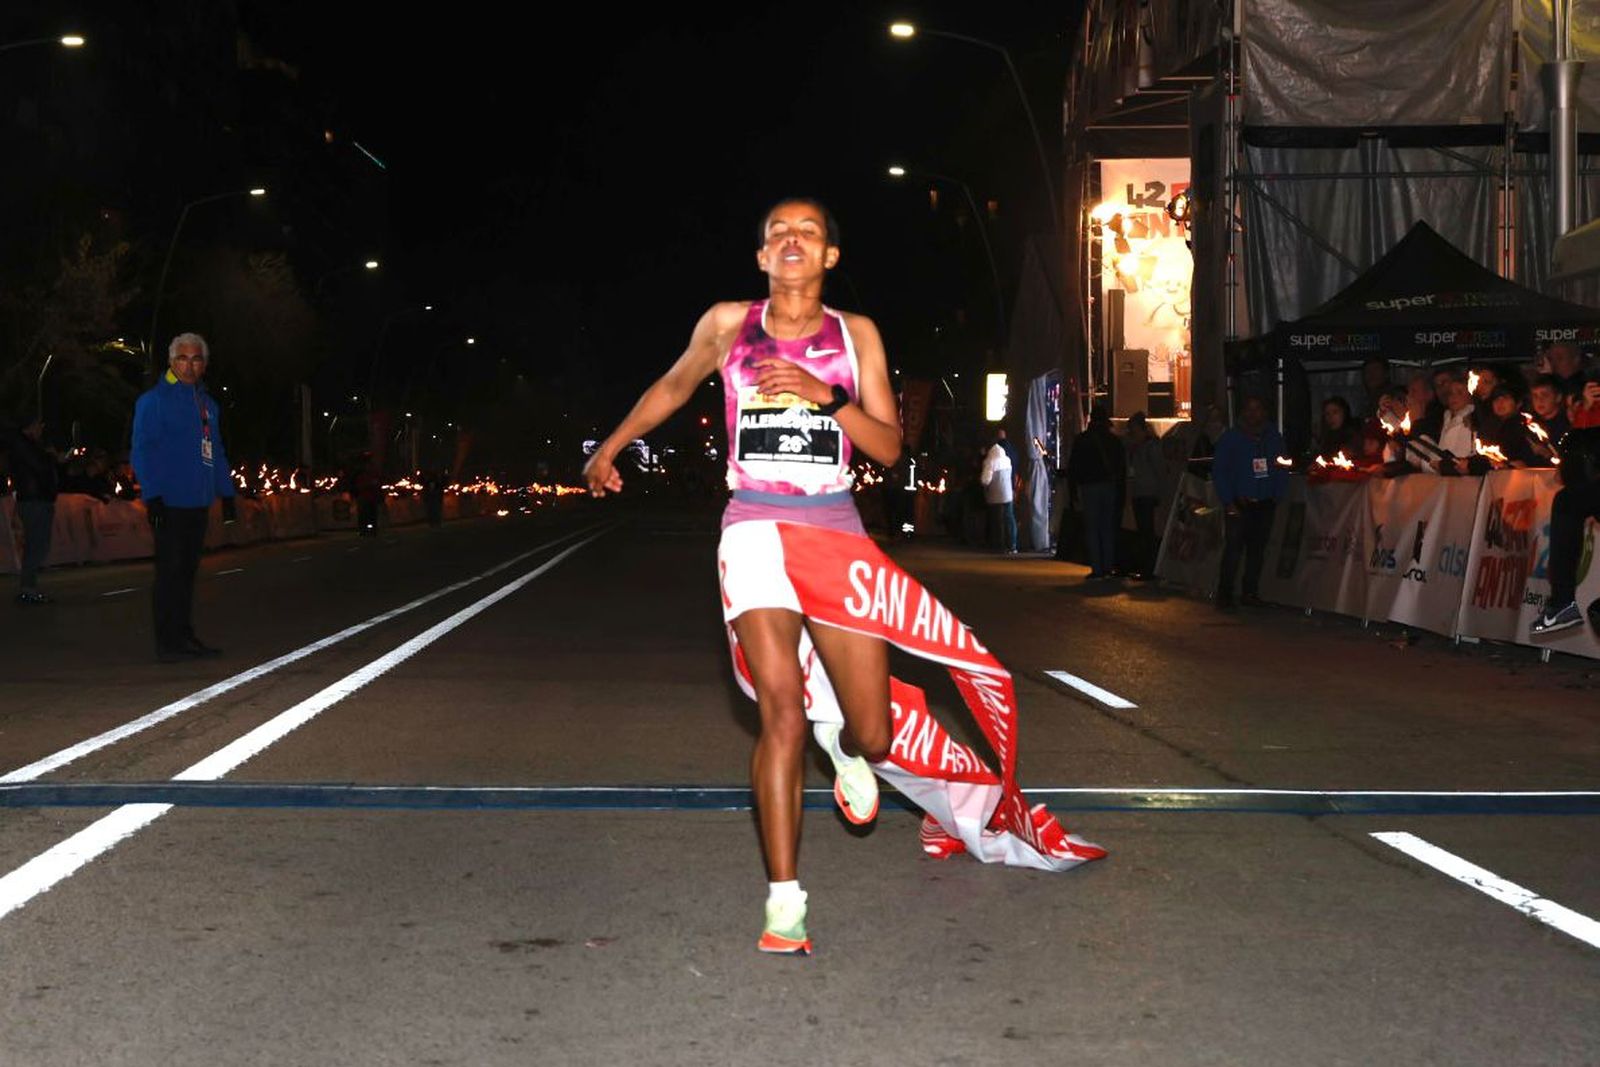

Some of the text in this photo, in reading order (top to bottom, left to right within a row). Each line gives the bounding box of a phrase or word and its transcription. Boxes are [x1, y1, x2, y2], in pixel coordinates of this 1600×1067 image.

[1290, 332, 1379, 351] superreen
[1415, 329, 1505, 349] superreen
[1438, 542, 1467, 578] als
[844, 560, 908, 631] SAN
